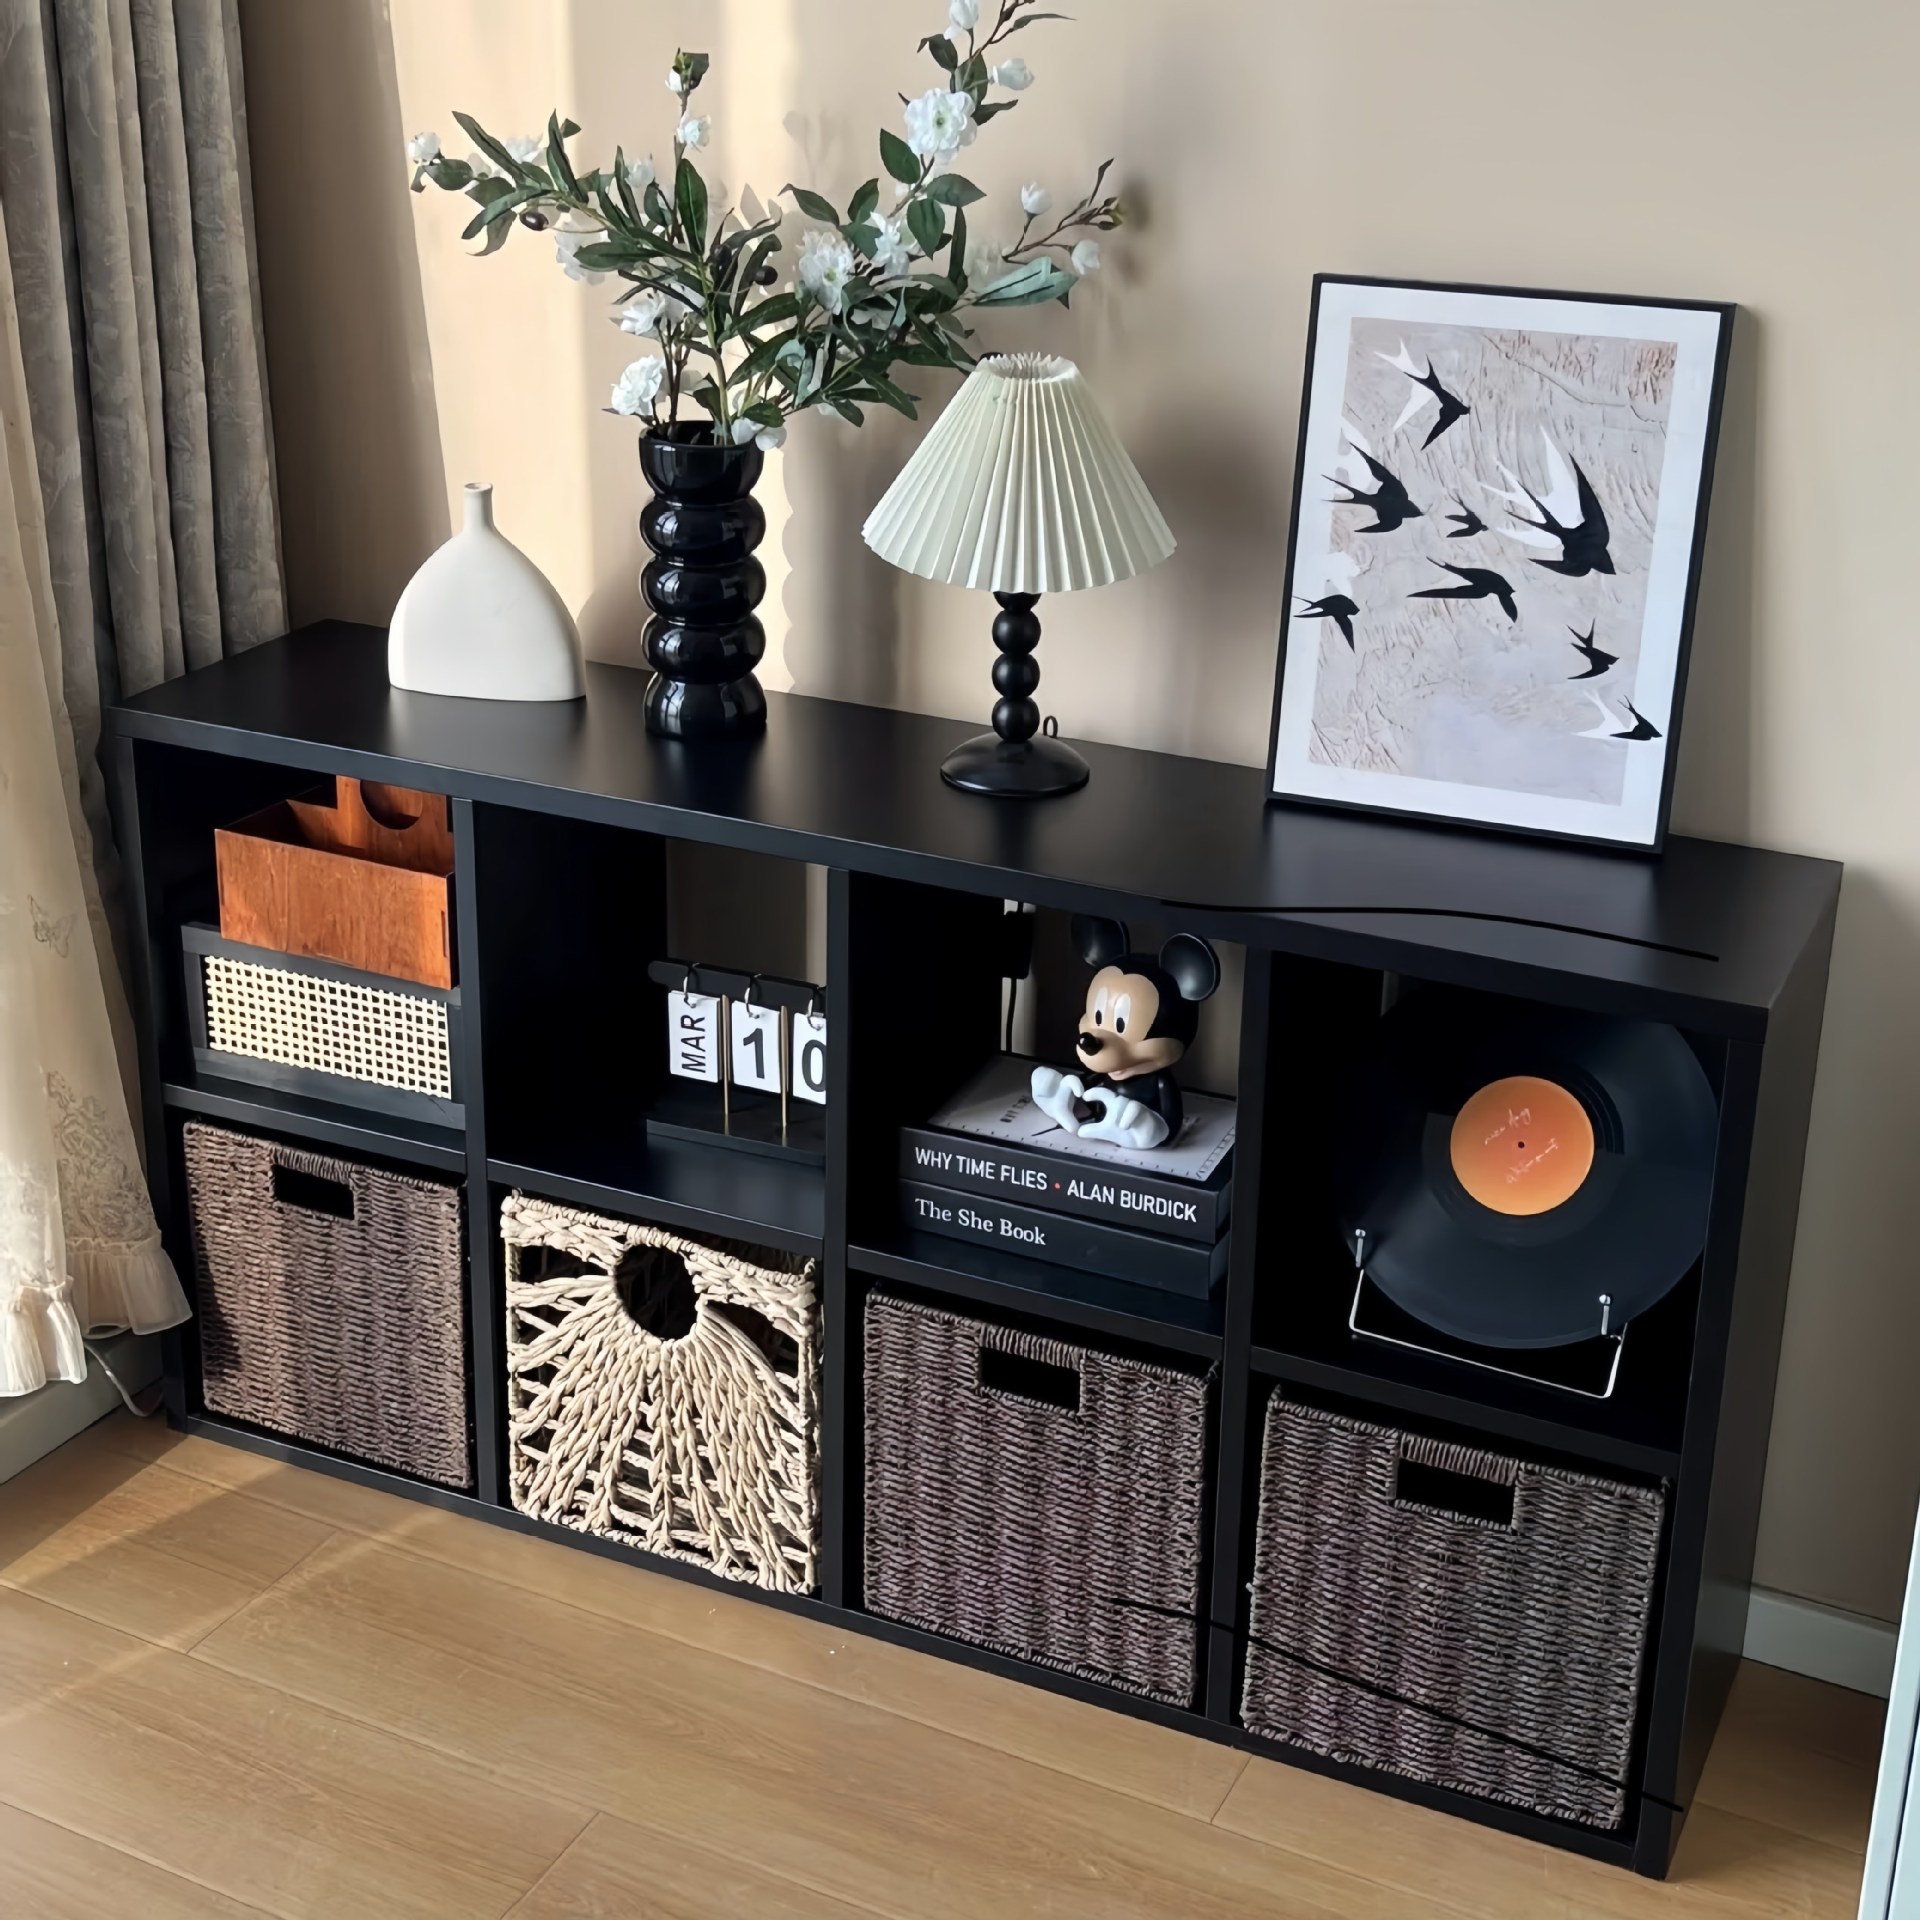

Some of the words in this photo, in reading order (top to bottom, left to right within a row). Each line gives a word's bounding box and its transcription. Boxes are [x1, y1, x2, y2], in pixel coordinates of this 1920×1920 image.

[680, 1014, 706, 1073] MAR
[743, 1027, 765, 1079] 1
[914, 1146, 953, 1170] WHY
[956, 1155, 996, 1180] TIME
[1000, 1164, 1048, 1191] FLIES
[1067, 1179, 1115, 1205] ALAN
[1120, 1189, 1197, 1223] BURDICK
[914, 1198, 952, 1222] The
[958, 1209, 994, 1233] She
[1000, 1218, 1047, 1246] Book
